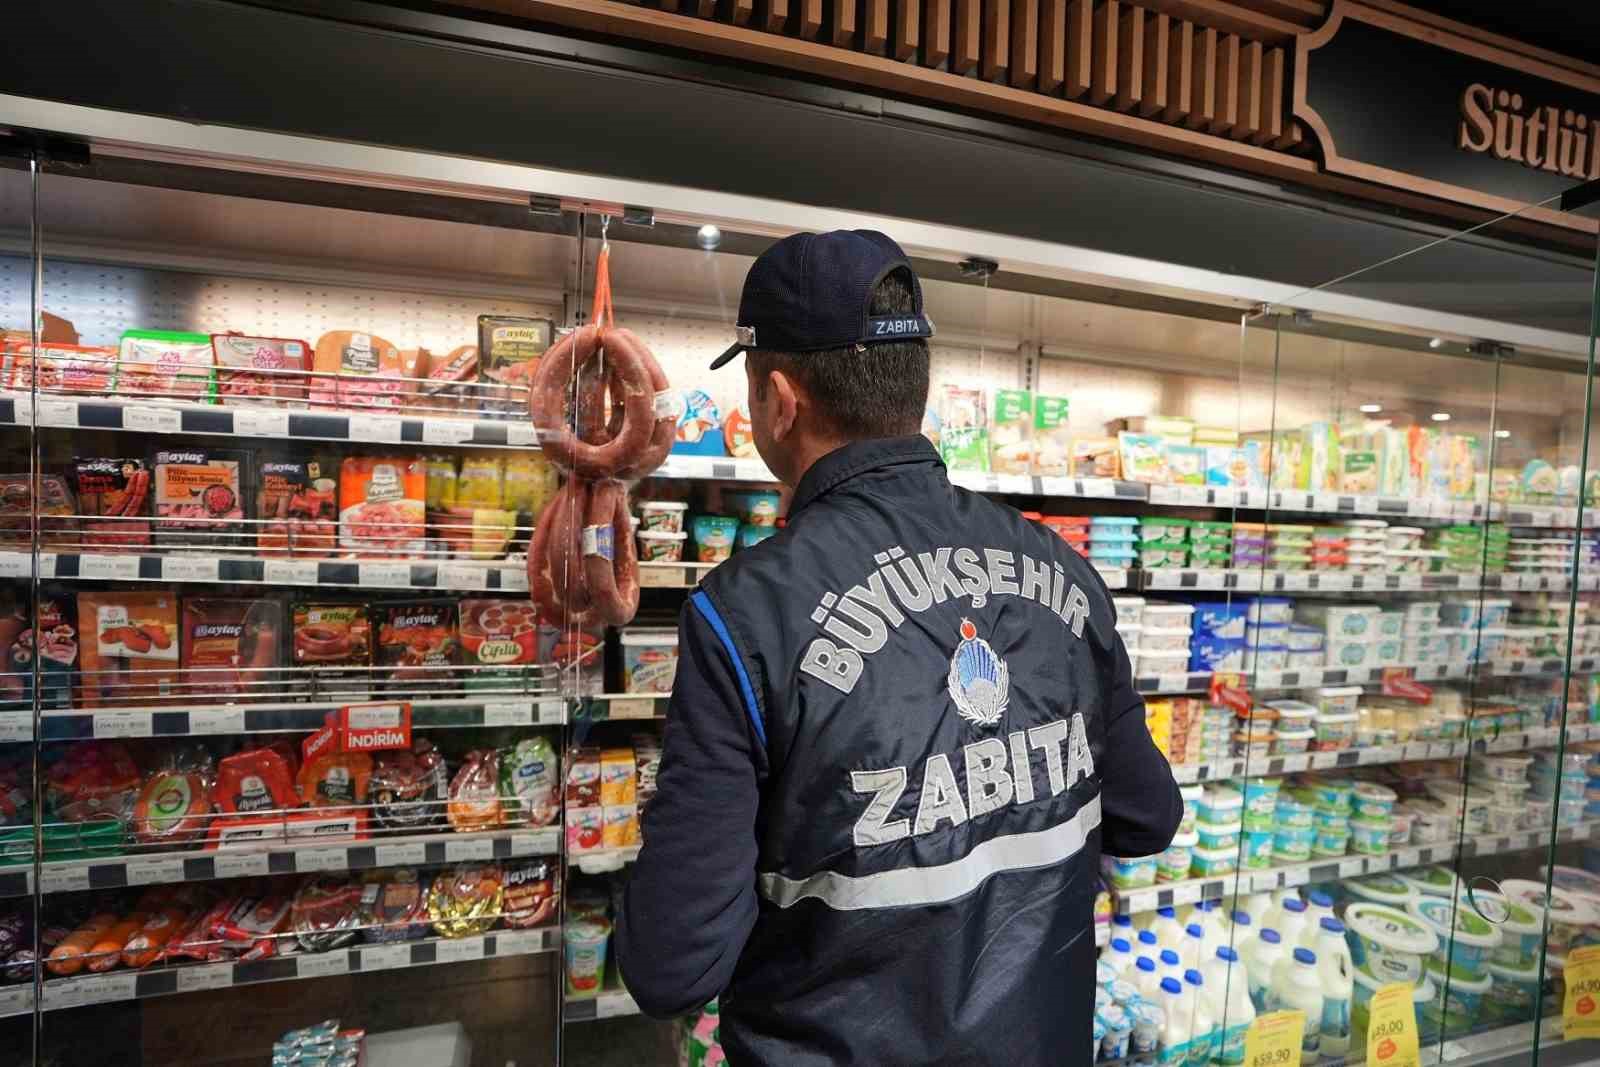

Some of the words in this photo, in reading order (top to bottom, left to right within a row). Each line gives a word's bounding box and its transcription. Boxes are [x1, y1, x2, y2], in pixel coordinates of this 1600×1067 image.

[875, 320, 920, 334] ZABITA
[800, 546, 1091, 695] BÜYÜKŞEHİR
[348, 730, 405, 749] İNDİRİM
[851, 712, 1095, 847] ZABITA
